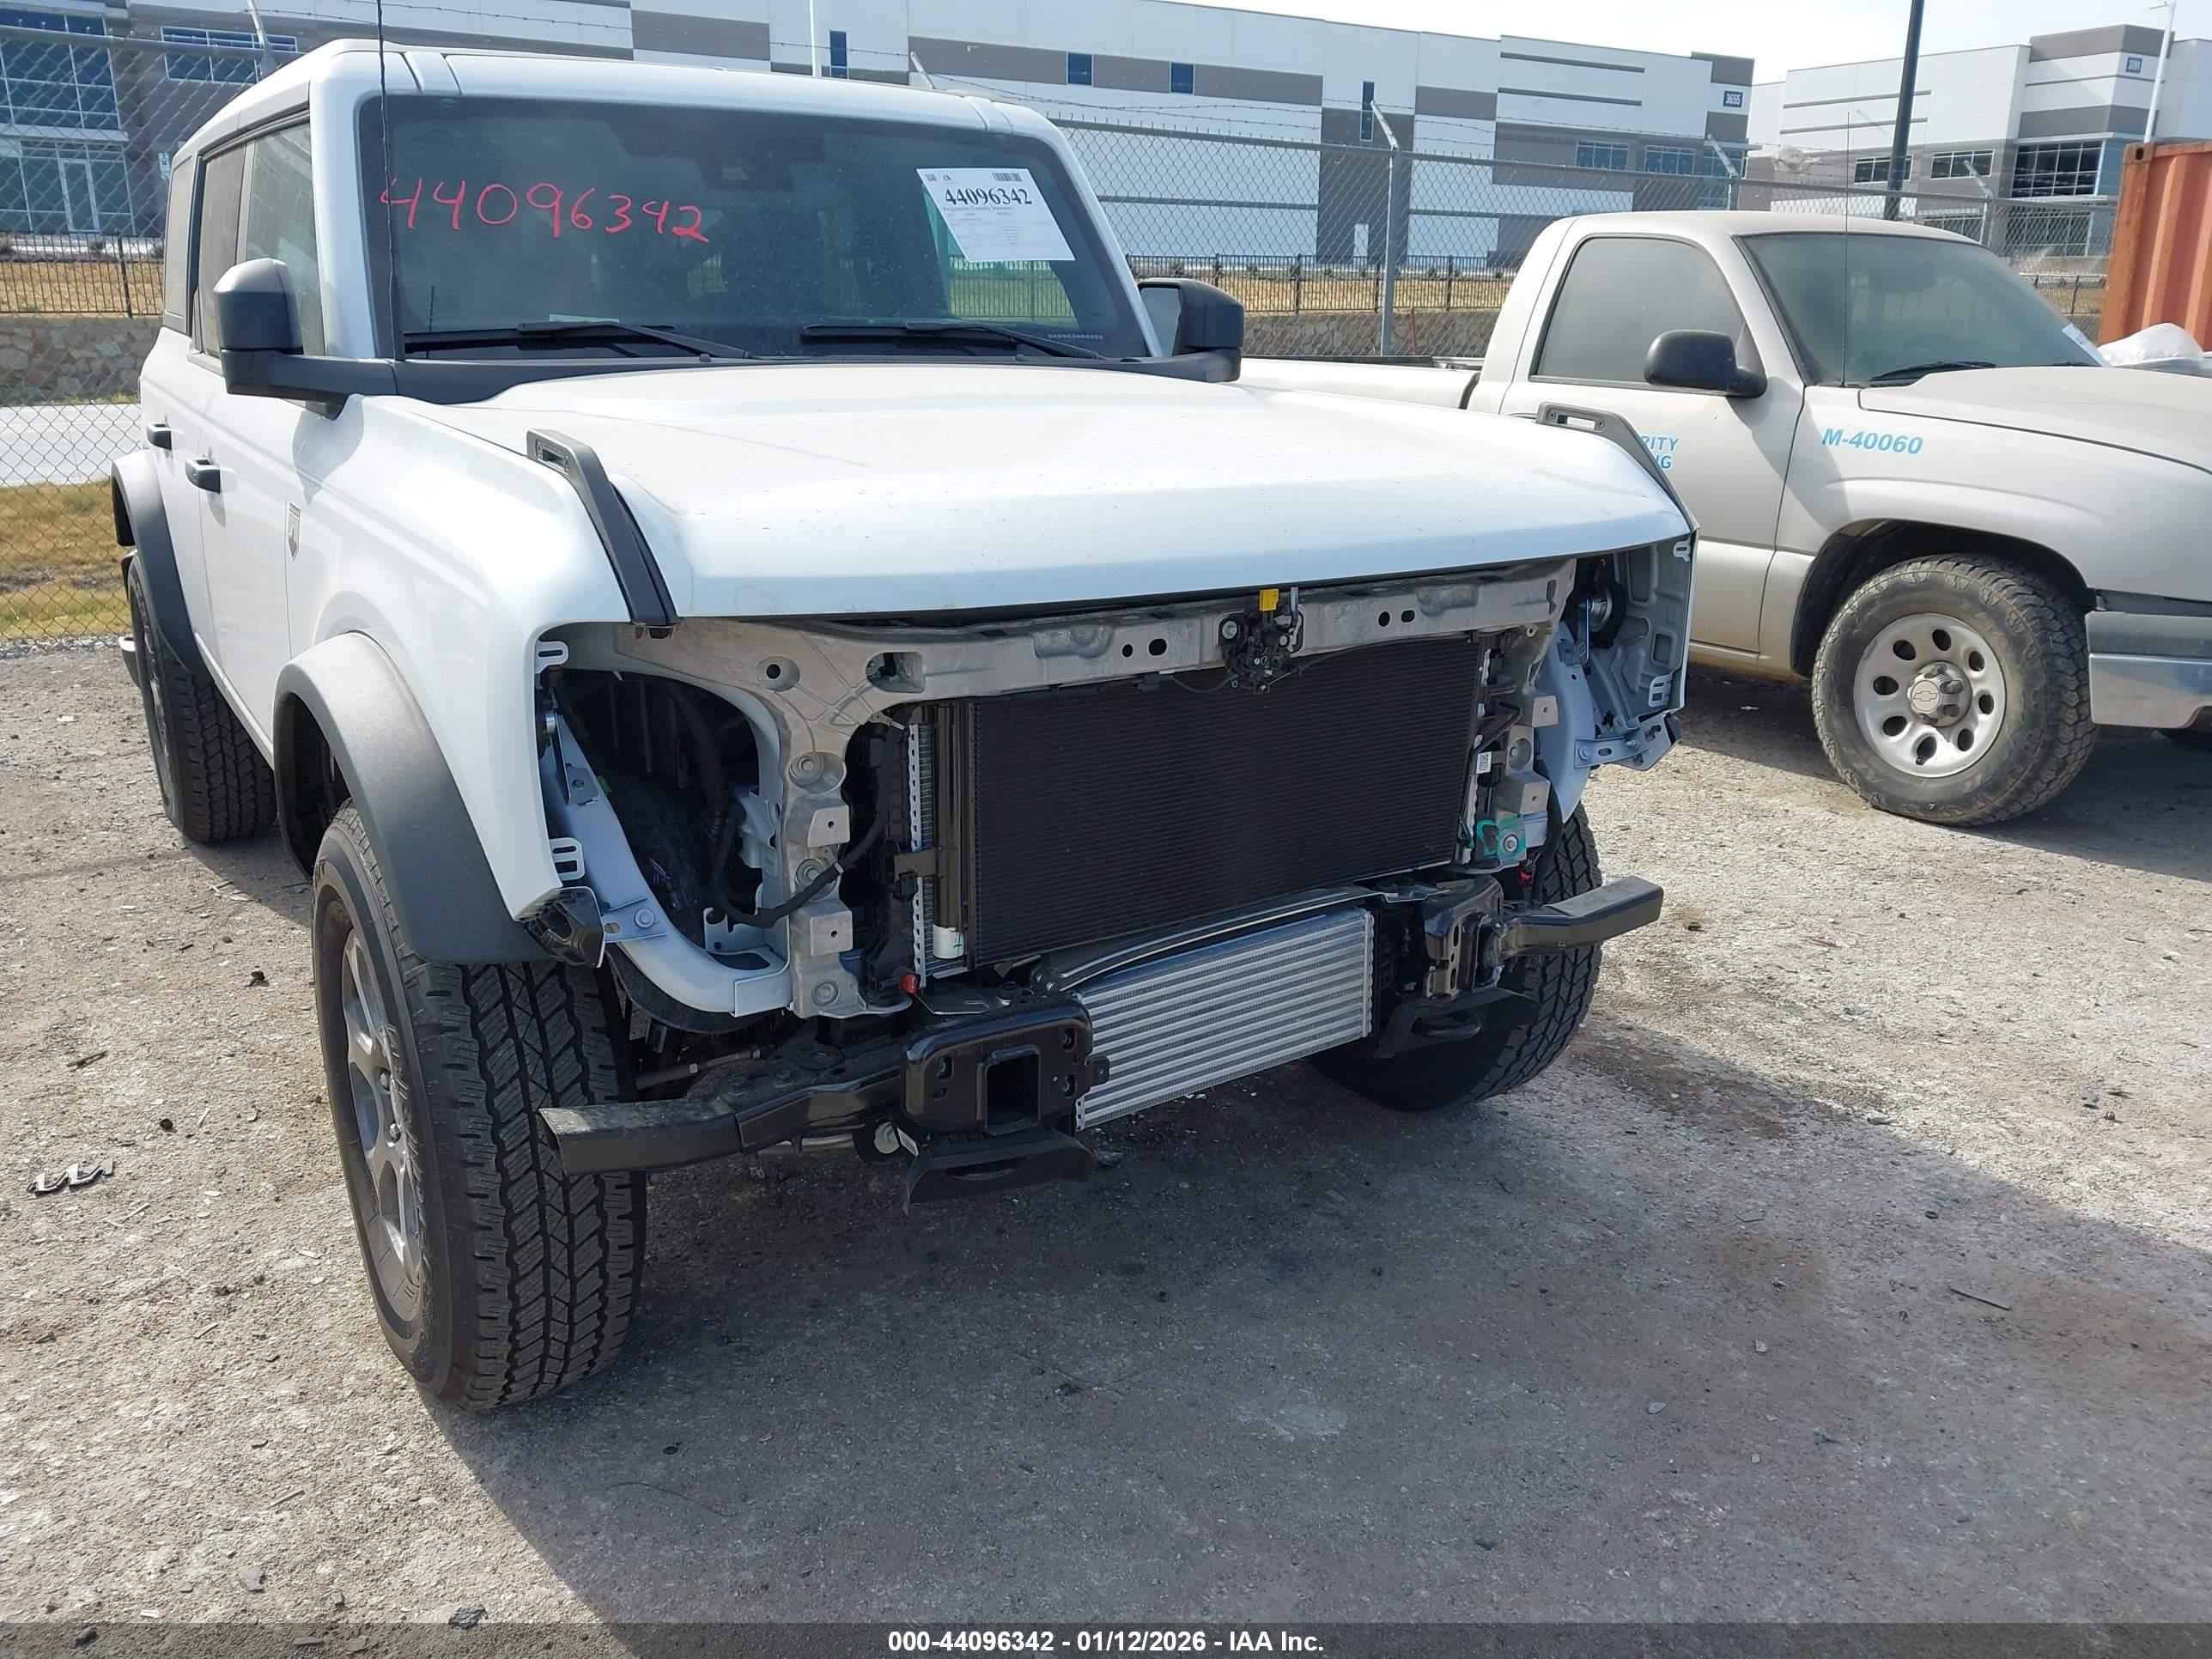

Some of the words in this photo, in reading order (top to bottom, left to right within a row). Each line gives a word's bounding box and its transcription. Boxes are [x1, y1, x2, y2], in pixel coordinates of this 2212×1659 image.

[945, 187, 1032, 204] 44096342
[380, 177, 709, 242] 44096342
[1821, 428, 1924, 455] M-40060
